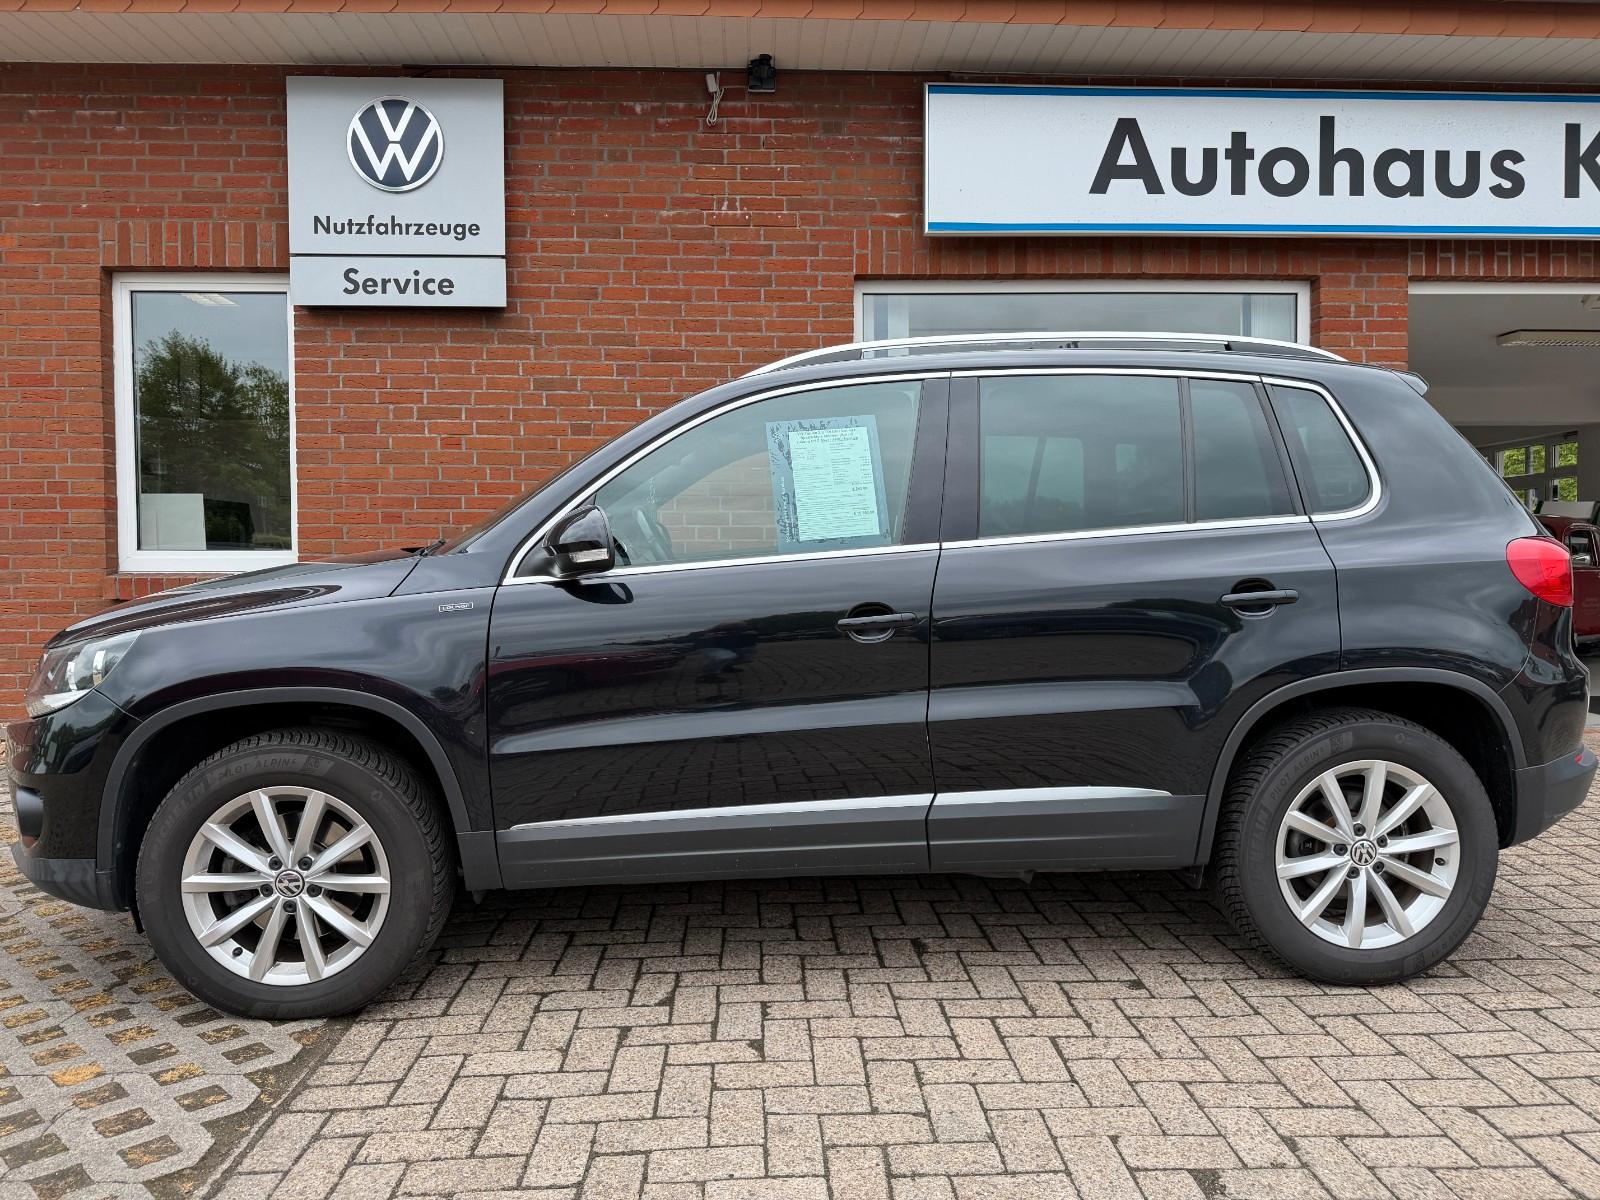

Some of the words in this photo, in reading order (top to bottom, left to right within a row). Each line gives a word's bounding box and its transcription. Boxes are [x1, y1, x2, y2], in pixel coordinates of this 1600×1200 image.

[348, 96, 443, 190] VW
[1088, 115, 1527, 199] Autohaus
[313, 214, 480, 241] Nutzfahrzeuge
[342, 267, 455, 296] Service
